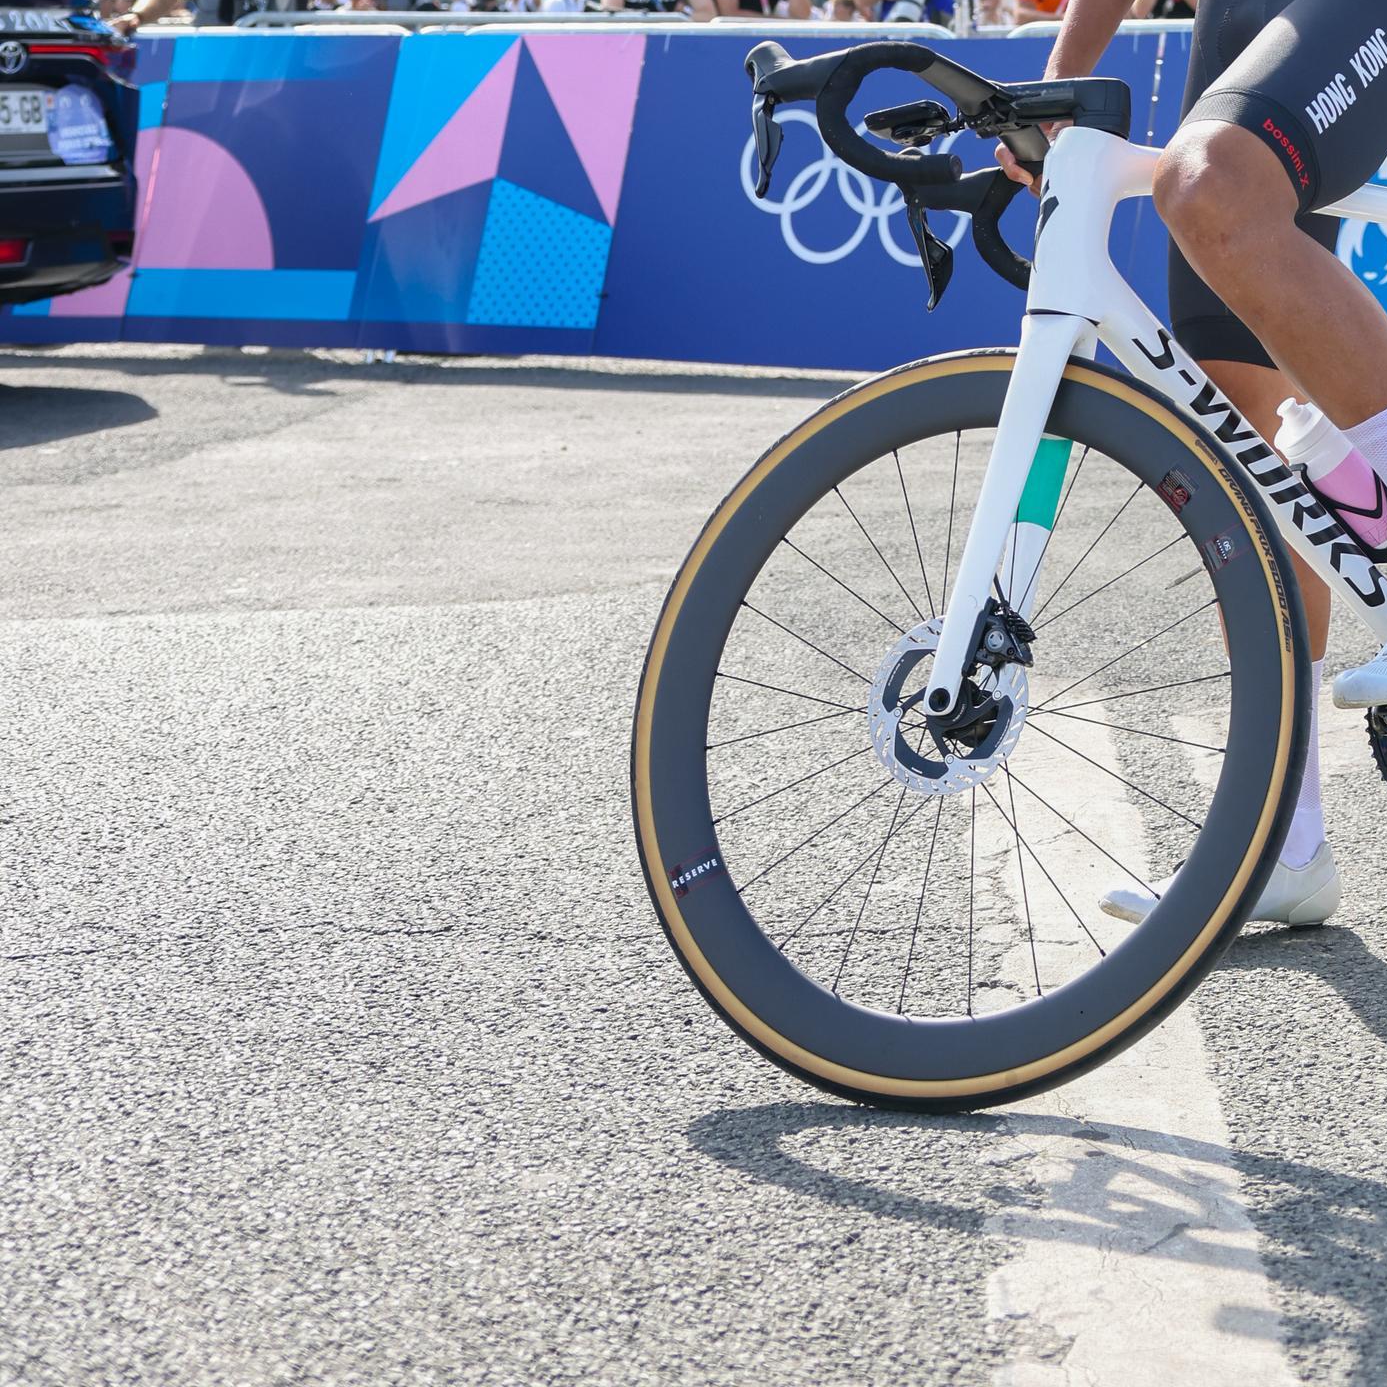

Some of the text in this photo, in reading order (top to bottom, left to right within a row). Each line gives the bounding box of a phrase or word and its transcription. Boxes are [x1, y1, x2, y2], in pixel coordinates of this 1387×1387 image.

[1305, 73, 1357, 134] HONG
[1262, 118, 1310, 190] bossini.X
[1132, 328, 1386, 607] S-WORKS
[1217, 467, 1253, 517] GRAND
[1250, 516, 1273, 557] PRIX
[1267, 558, 1288, 610] 5000
[671, 858, 718, 889] RESERVE
